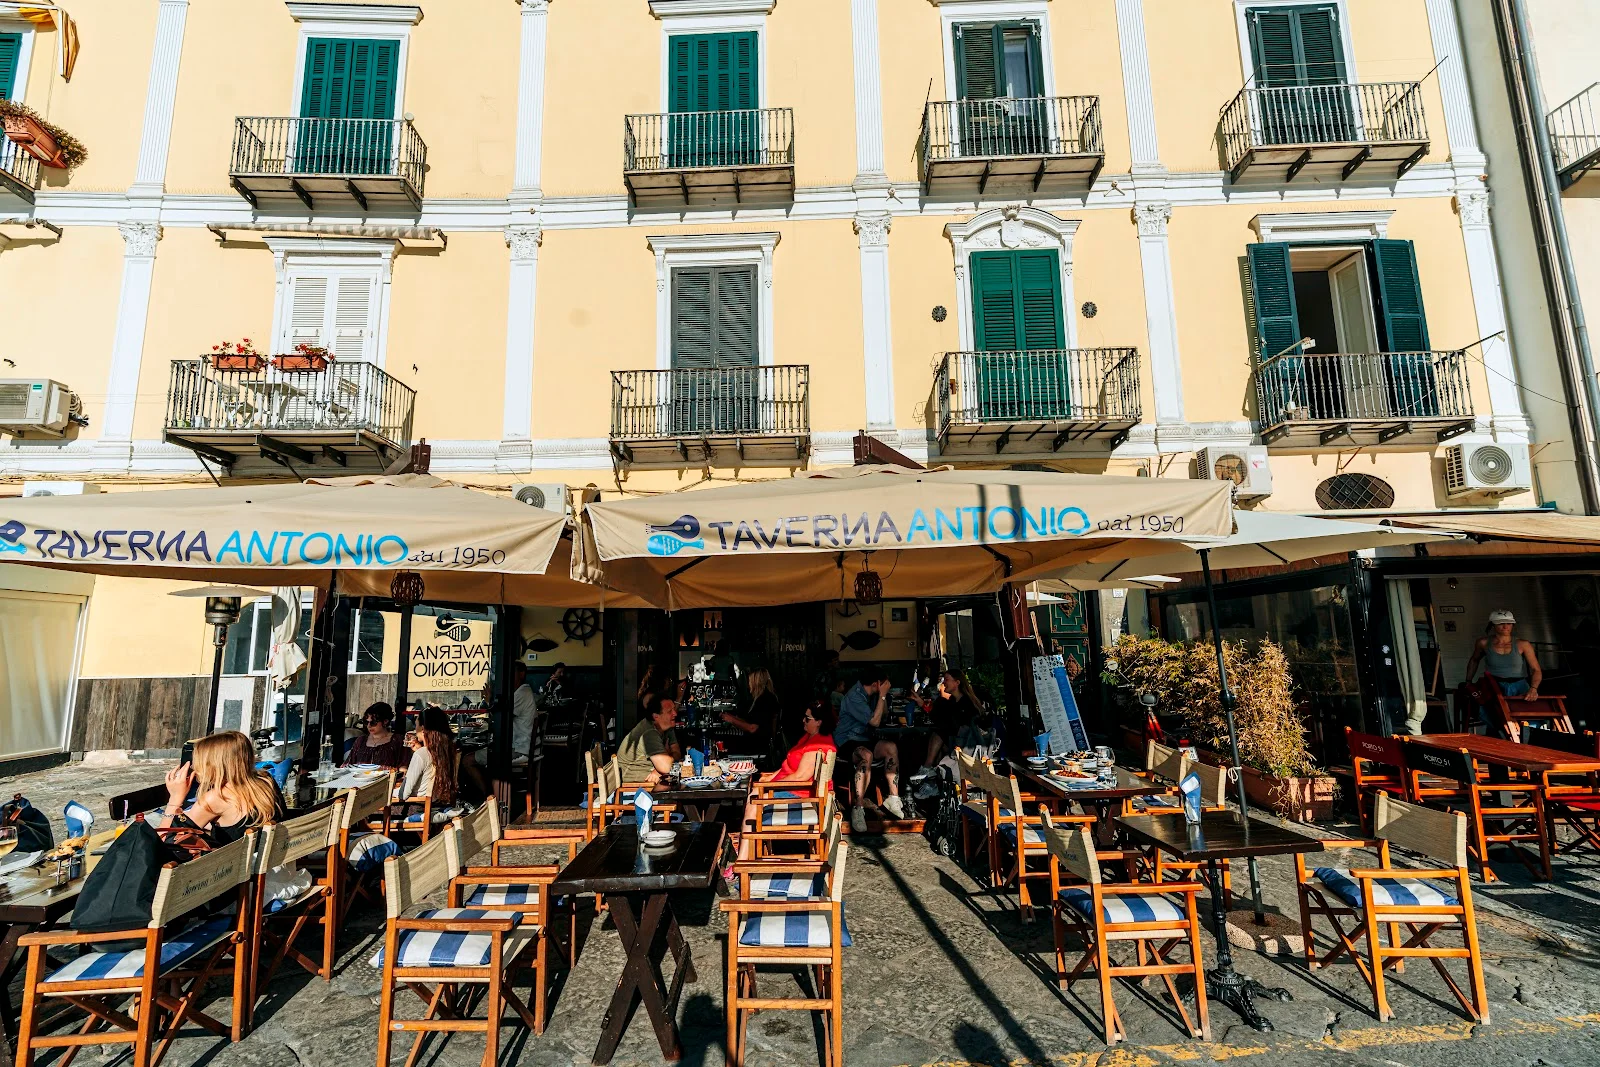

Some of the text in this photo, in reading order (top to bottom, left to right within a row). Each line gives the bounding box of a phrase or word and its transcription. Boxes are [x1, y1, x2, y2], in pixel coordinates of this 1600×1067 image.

[906, 506, 1091, 542] ANTONIO
[1139, 514, 1184, 534] 1950
[215, 529, 409, 565] ANTONIO
[451, 546, 506, 565] 1950
